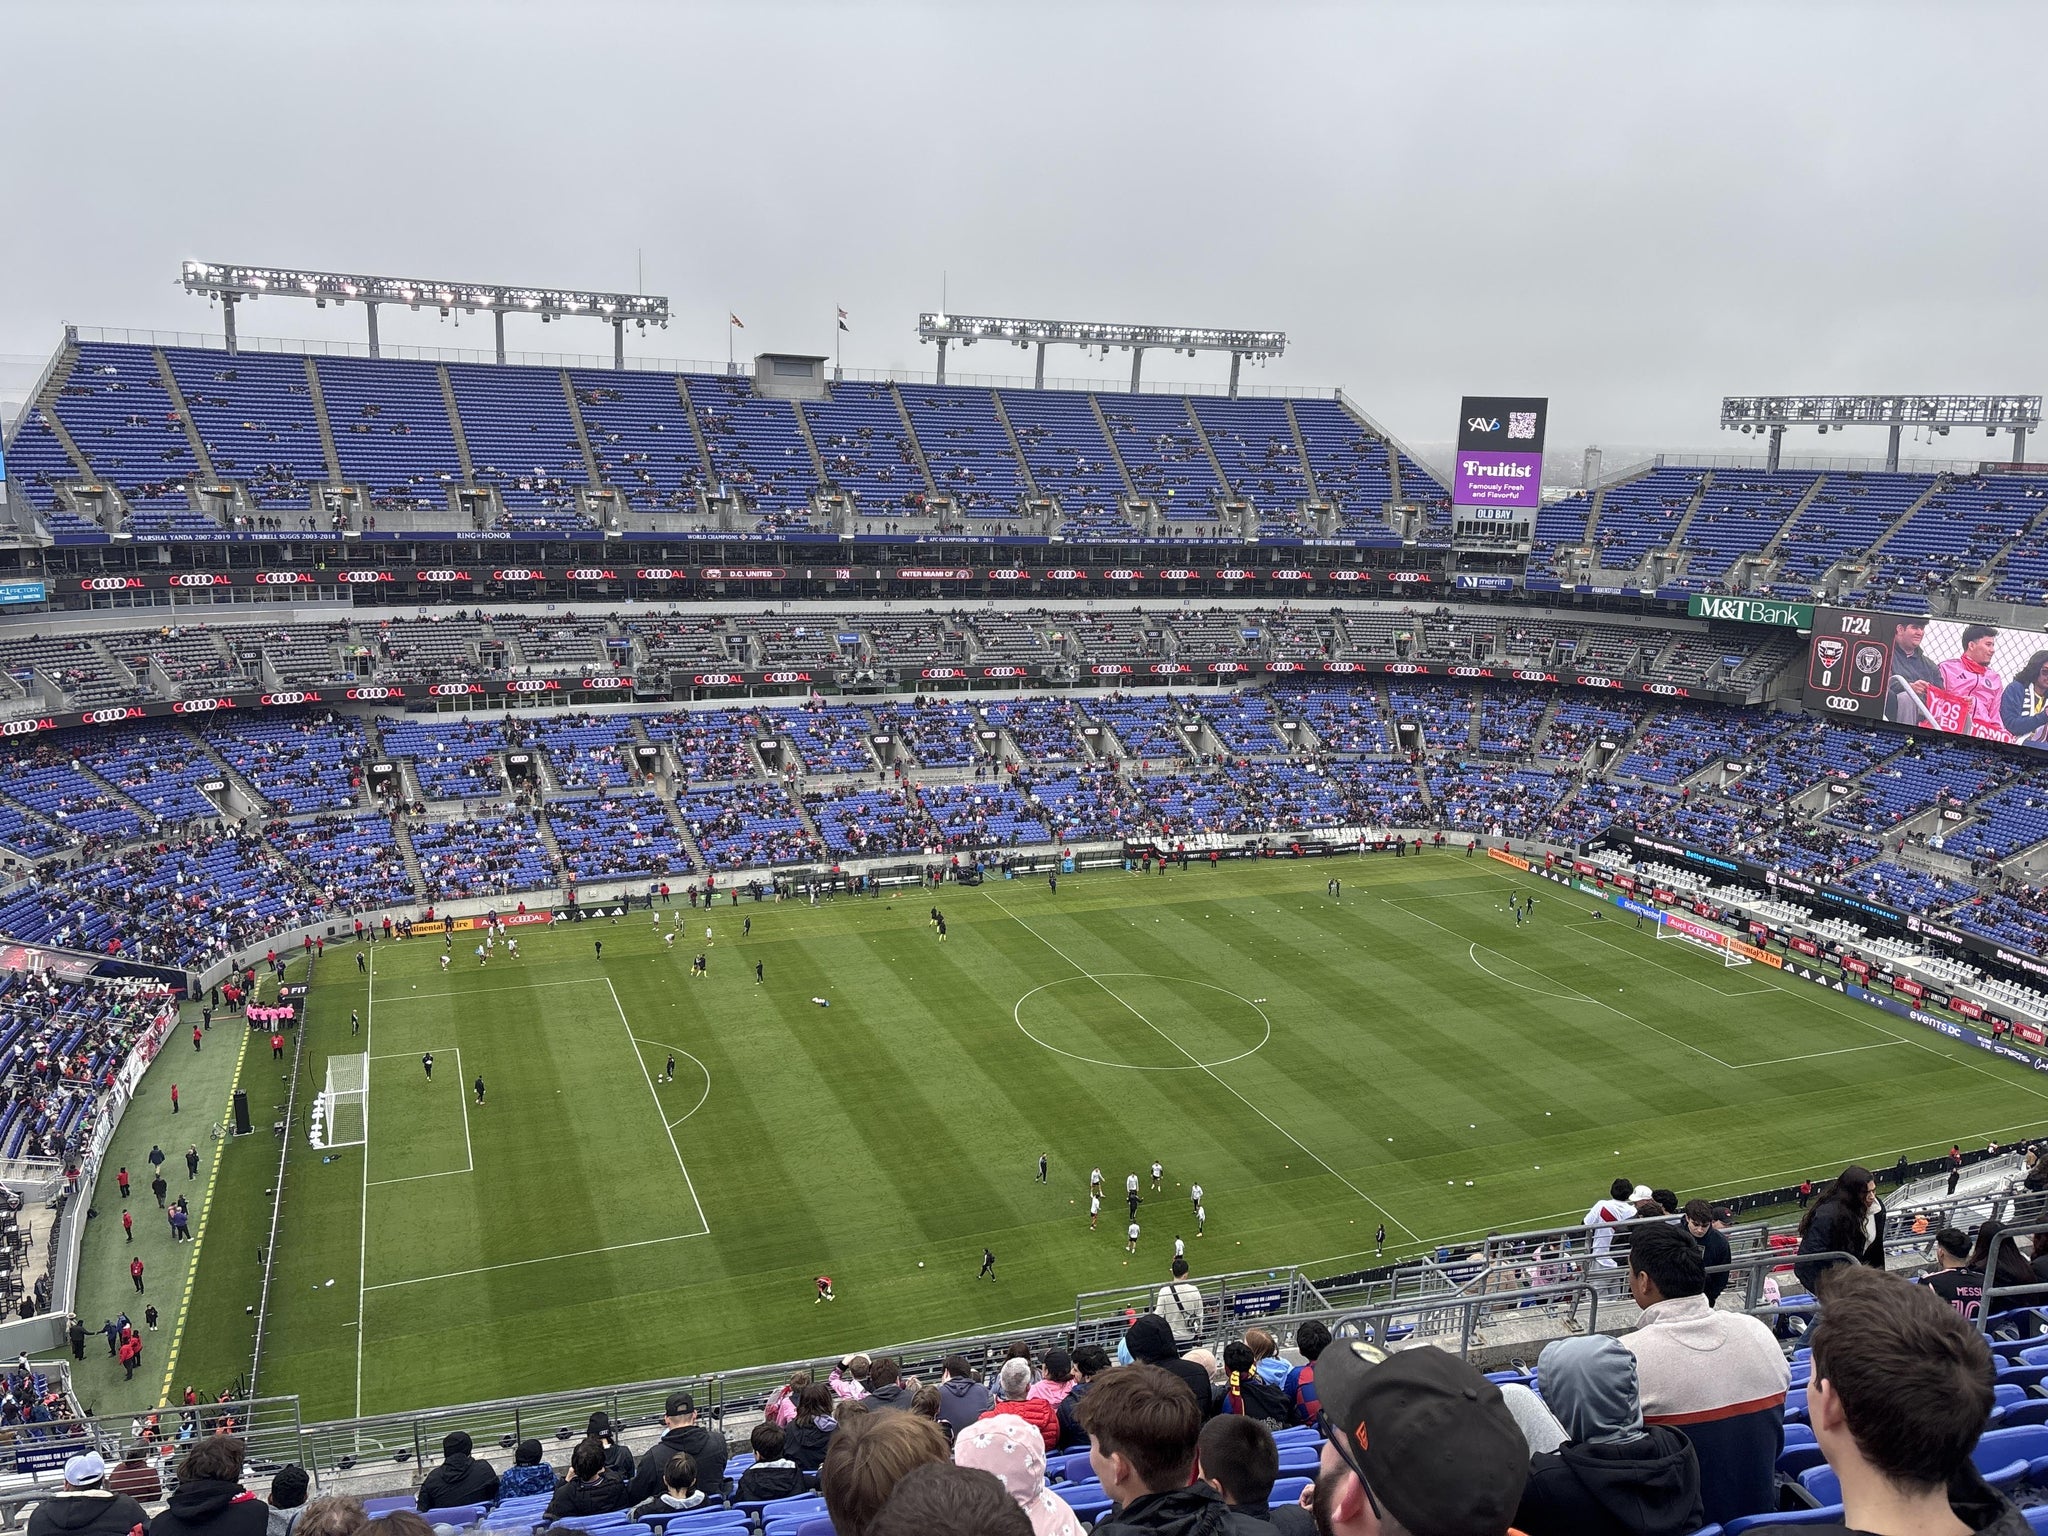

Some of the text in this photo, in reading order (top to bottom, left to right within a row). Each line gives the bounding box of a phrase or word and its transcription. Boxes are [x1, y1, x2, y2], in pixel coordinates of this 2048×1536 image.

[1463, 461, 1531, 478] Fruitist
[1469, 483, 1502, 491] Famously
[1478, 509, 1512, 519] OLD BAY
[1478, 578, 1506, 586] merritt
[1699, 597, 1800, 626] M&T Bank
[1841, 616, 1871, 635] 17:24
[1822, 670, 1832, 687] 0
[1861, 676, 1871, 693] 0
[1634, 836, 1739, 871] Better questions. Better outcomes.
[1624, 900, 1660, 920] ticketmaster
[1821, 891, 1898, 921] INVEST WITH CONFIDENCE
[1996, 949, 2022, 966] Better
[291, 986, 307, 994] FIT
[1903, 982, 1920, 995] UNITED
[1930, 993, 1948, 1005] UNITED
[1960, 1004, 1978, 1016] UNITED
[2022, 1030, 2042, 1042] UNITED
[1242, 1296, 1259, 1304] STANDING
[26, 1454, 52, 1463] STANDING
